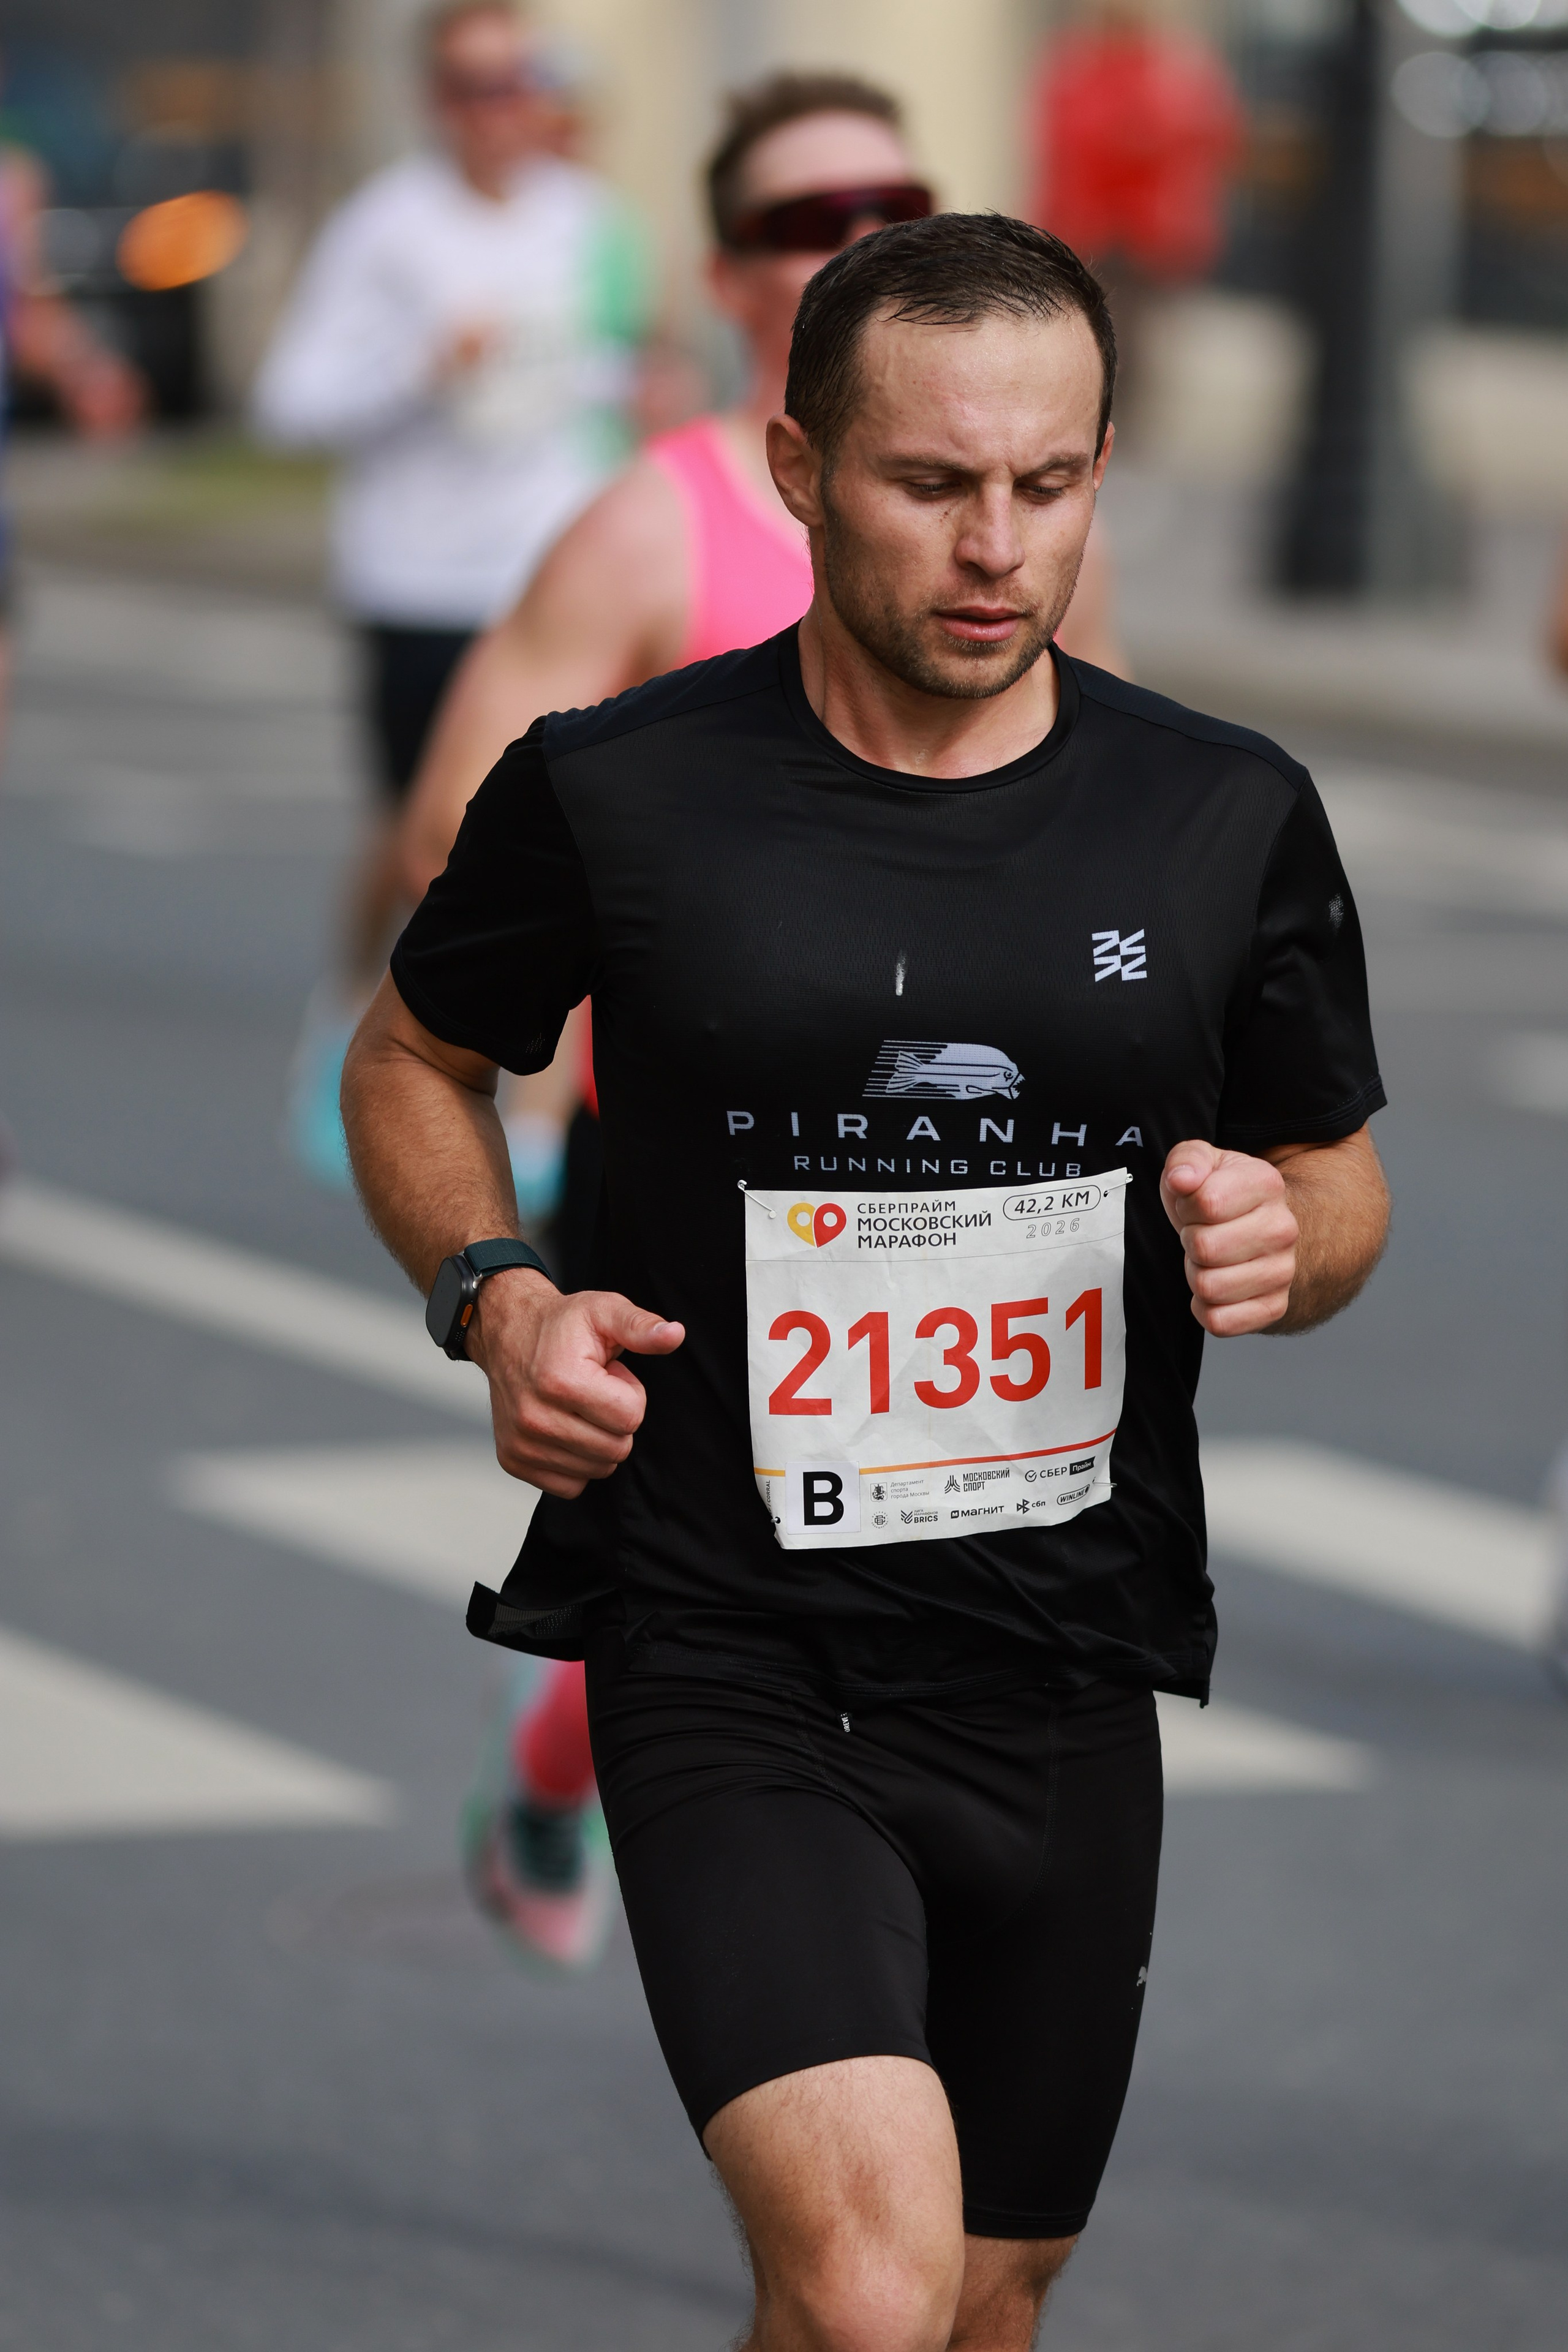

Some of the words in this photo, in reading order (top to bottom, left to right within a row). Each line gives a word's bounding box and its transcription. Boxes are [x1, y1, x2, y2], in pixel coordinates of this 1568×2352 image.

[726, 1110, 1144, 1147] PIRANHA
[794, 1155, 968, 1174] RUNNING
[990, 1160, 1082, 1177] CLUB
[857, 1199, 956, 1215] СБЕРПРАЙМ
[1014, 1197, 1055, 1215] 42,2
[1061, 1191, 1091, 1208] КМ
[857, 1211, 992, 1232] МОСКОВСКИЙ
[1026, 1217, 1081, 1239] 2026
[858, 1232, 957, 1249] МАРАФОН
[768, 1287, 1102, 1416] 21351
[962, 1468, 1010, 1482] МОСКОВСКИЙ
[1039, 1466, 1068, 1479] СБЕР
[1072, 1461, 1092, 1472] Прайм
[963, 1481, 986, 1492] СПОРТ
[1060, 1489, 1085, 1503] WINLINE
[802, 1471, 845, 1526] B
[914, 1515, 938, 1524] BRICS
